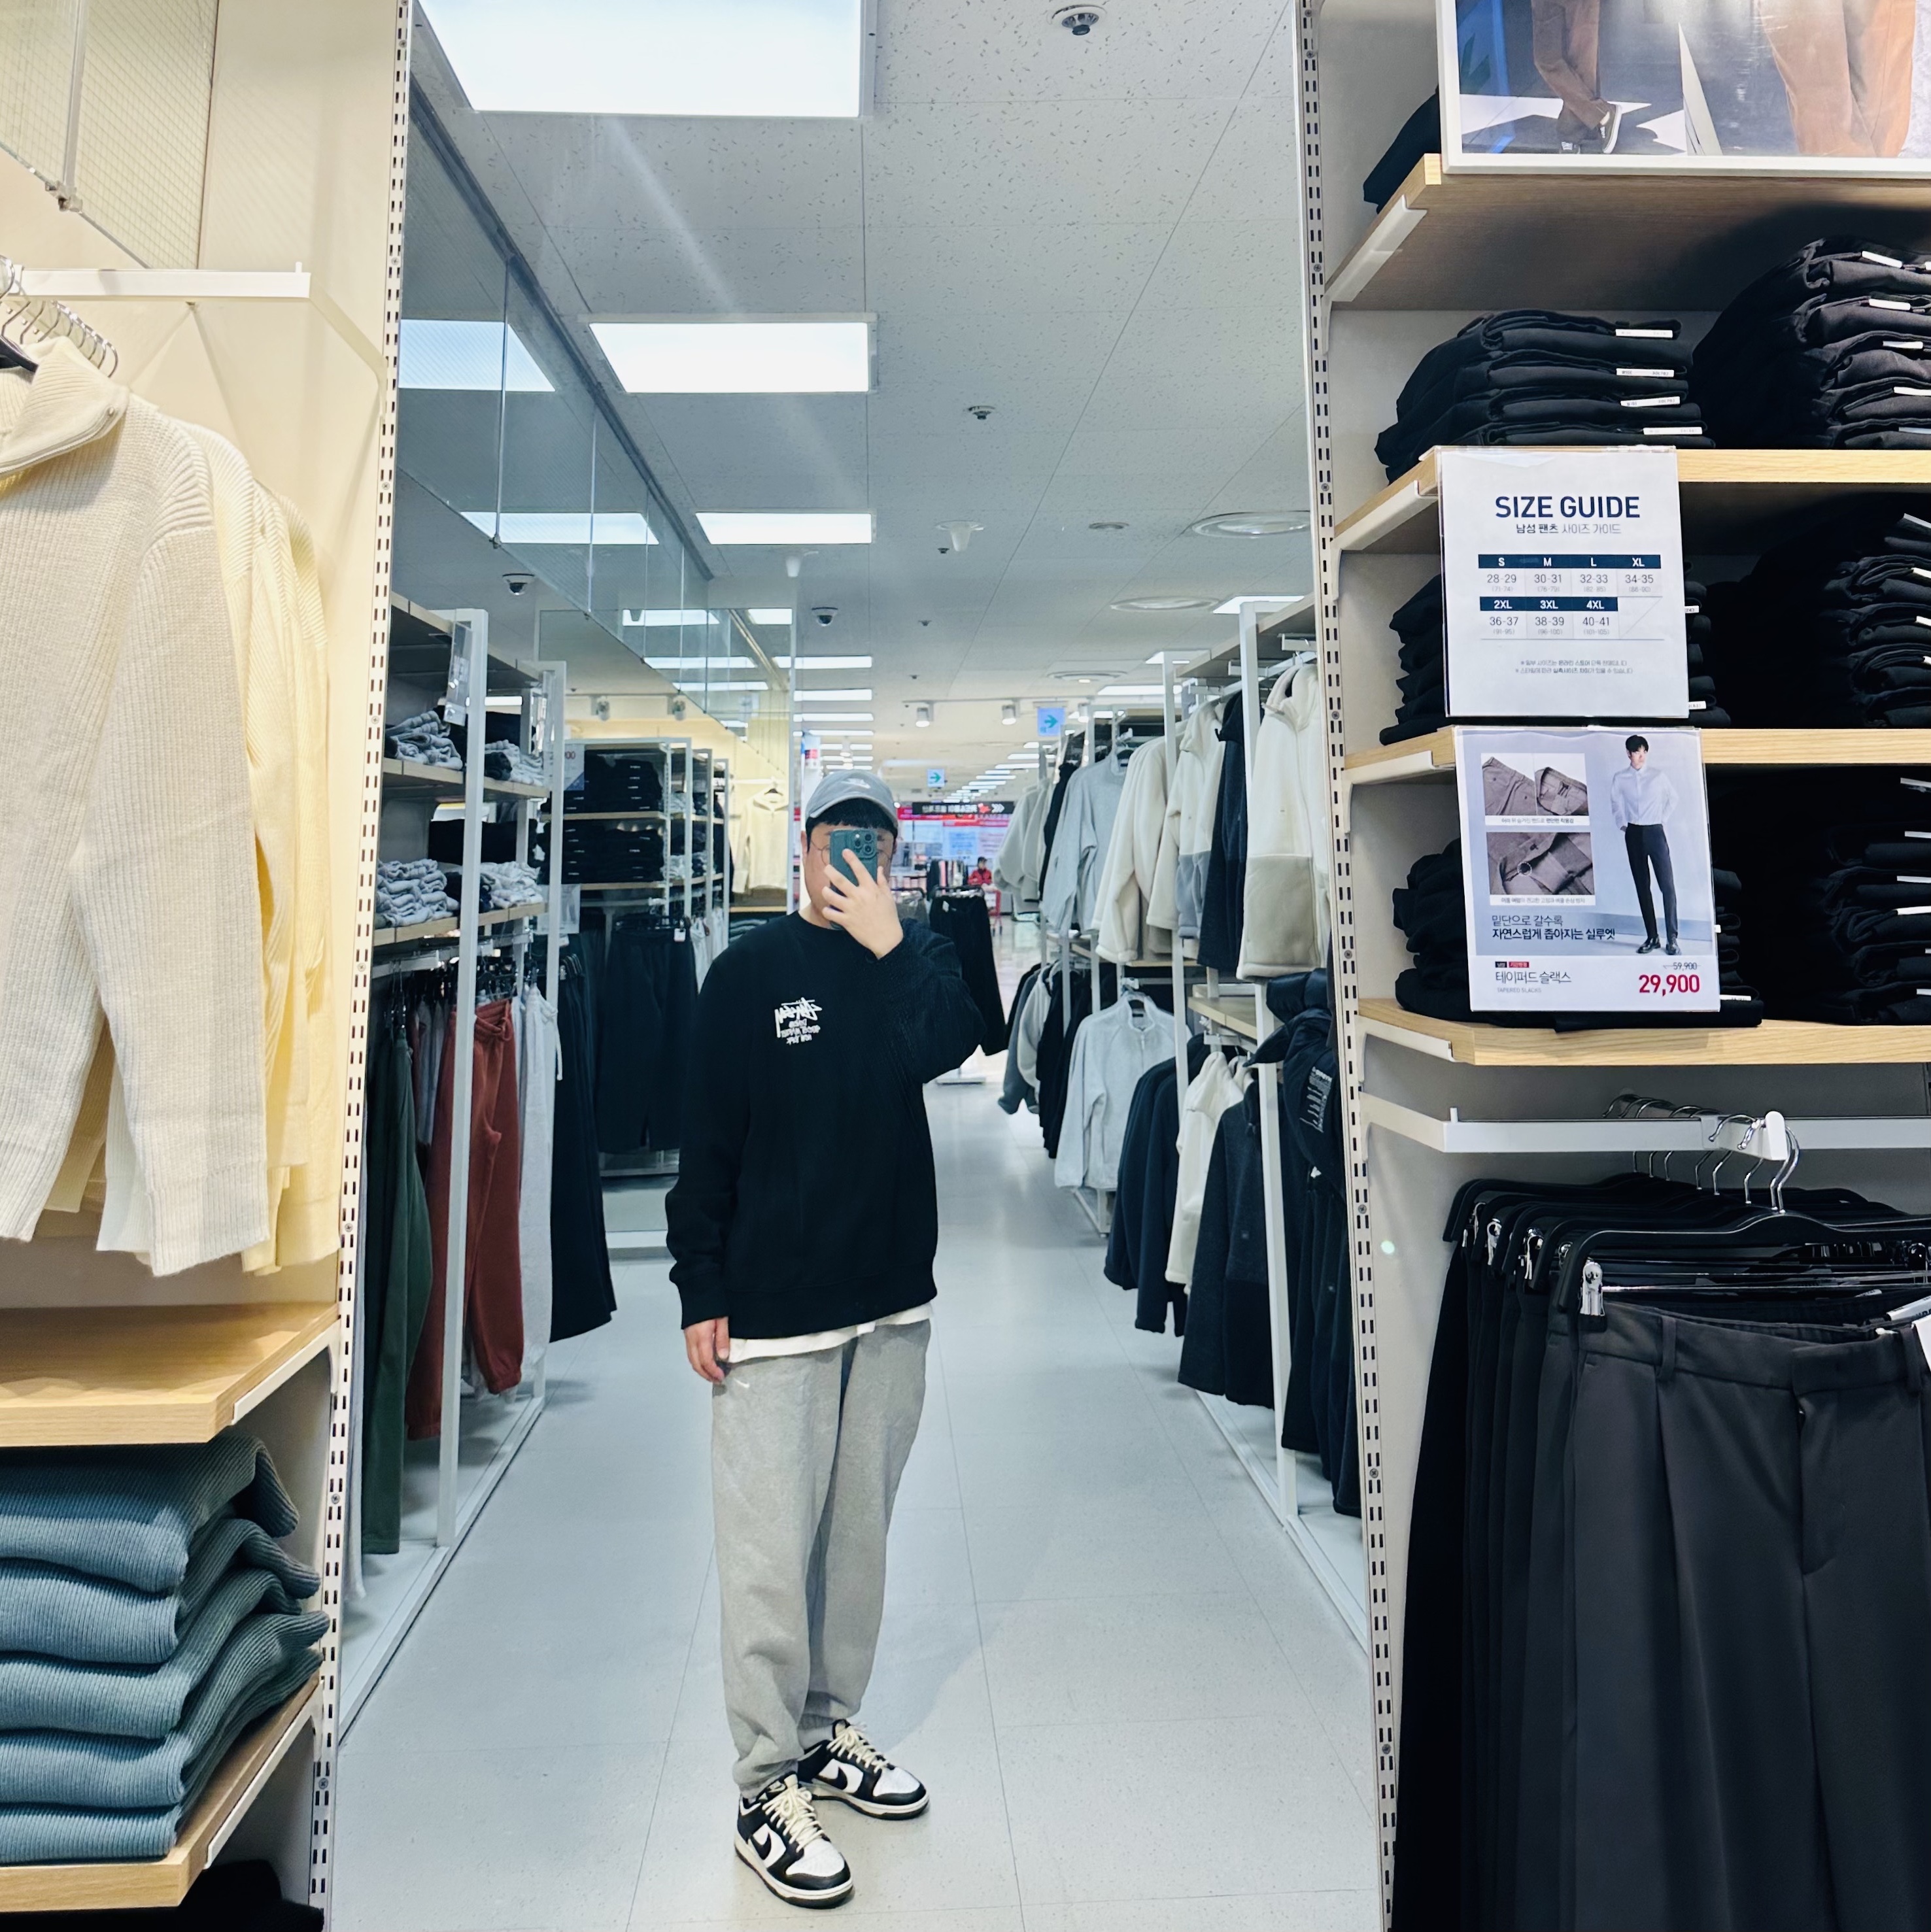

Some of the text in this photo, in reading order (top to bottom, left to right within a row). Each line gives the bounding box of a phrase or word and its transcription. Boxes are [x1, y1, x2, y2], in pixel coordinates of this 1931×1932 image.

[1495, 496, 1641, 518] SIZE GUIDE
[1516, 524, 1622, 534] 남성 팬츠 사이즈 가이드
[1498, 558, 1645, 566] S M L XL
[1487, 574, 1654, 583] 28-29 30-31 32-33 34-35
[1494, 600, 1605, 609] 2XL 3XL 4XL
[1490, 617, 1610, 626] 36-37 38-39 40-41
[1492, 915, 1564, 926] 밑단으로 갈수록
[1492, 928, 1541, 940] 자연스럽게
[1544, 928, 1583, 940] 좁아지는
[1673, 962, 1698, 971] 59,900
[1495, 972, 1572, 984] 테이퍼드 슬랙스
[1639, 974, 1700, 996] 29,900
